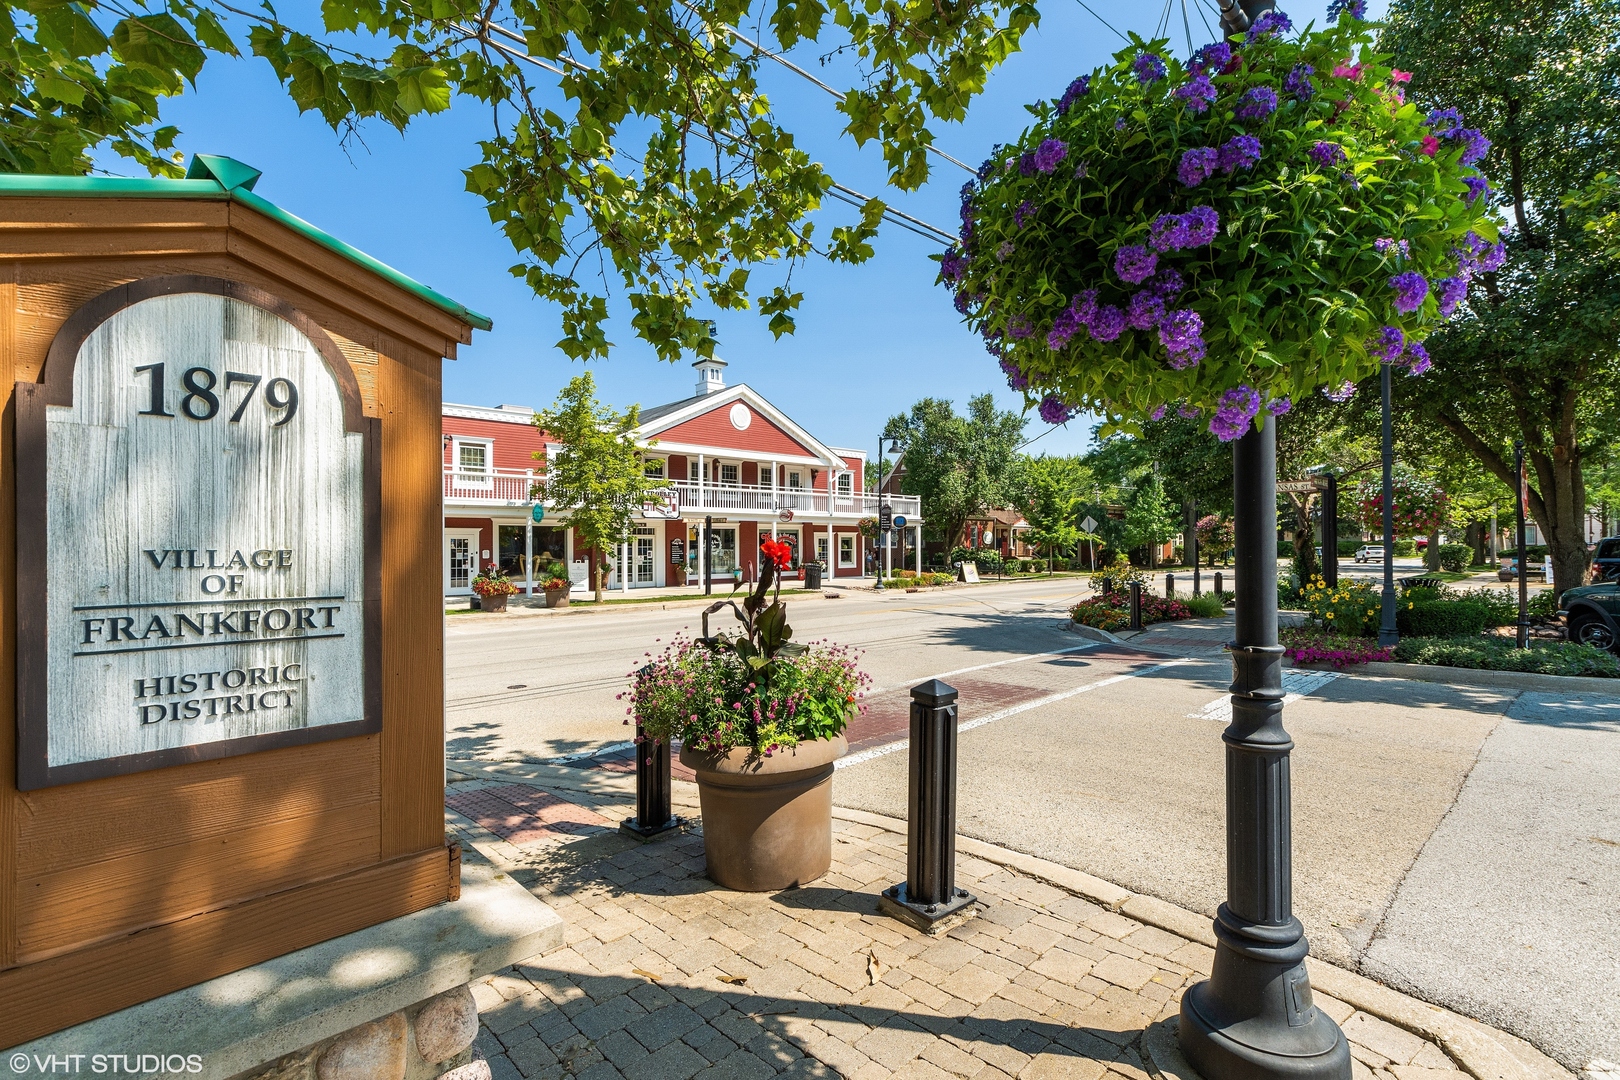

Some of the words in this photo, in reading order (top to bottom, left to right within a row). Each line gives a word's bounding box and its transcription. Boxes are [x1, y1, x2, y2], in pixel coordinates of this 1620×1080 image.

[135, 362, 298, 427] 1879
[1276, 482, 1298, 491] NSAS
[144, 549, 293, 569] VILLAGE
[200, 574, 244, 594] OF
[80, 606, 341, 645] FRANKFORT
[135, 663, 303, 698] HISTORIC
[138, 687, 297, 726] DISTRICT
